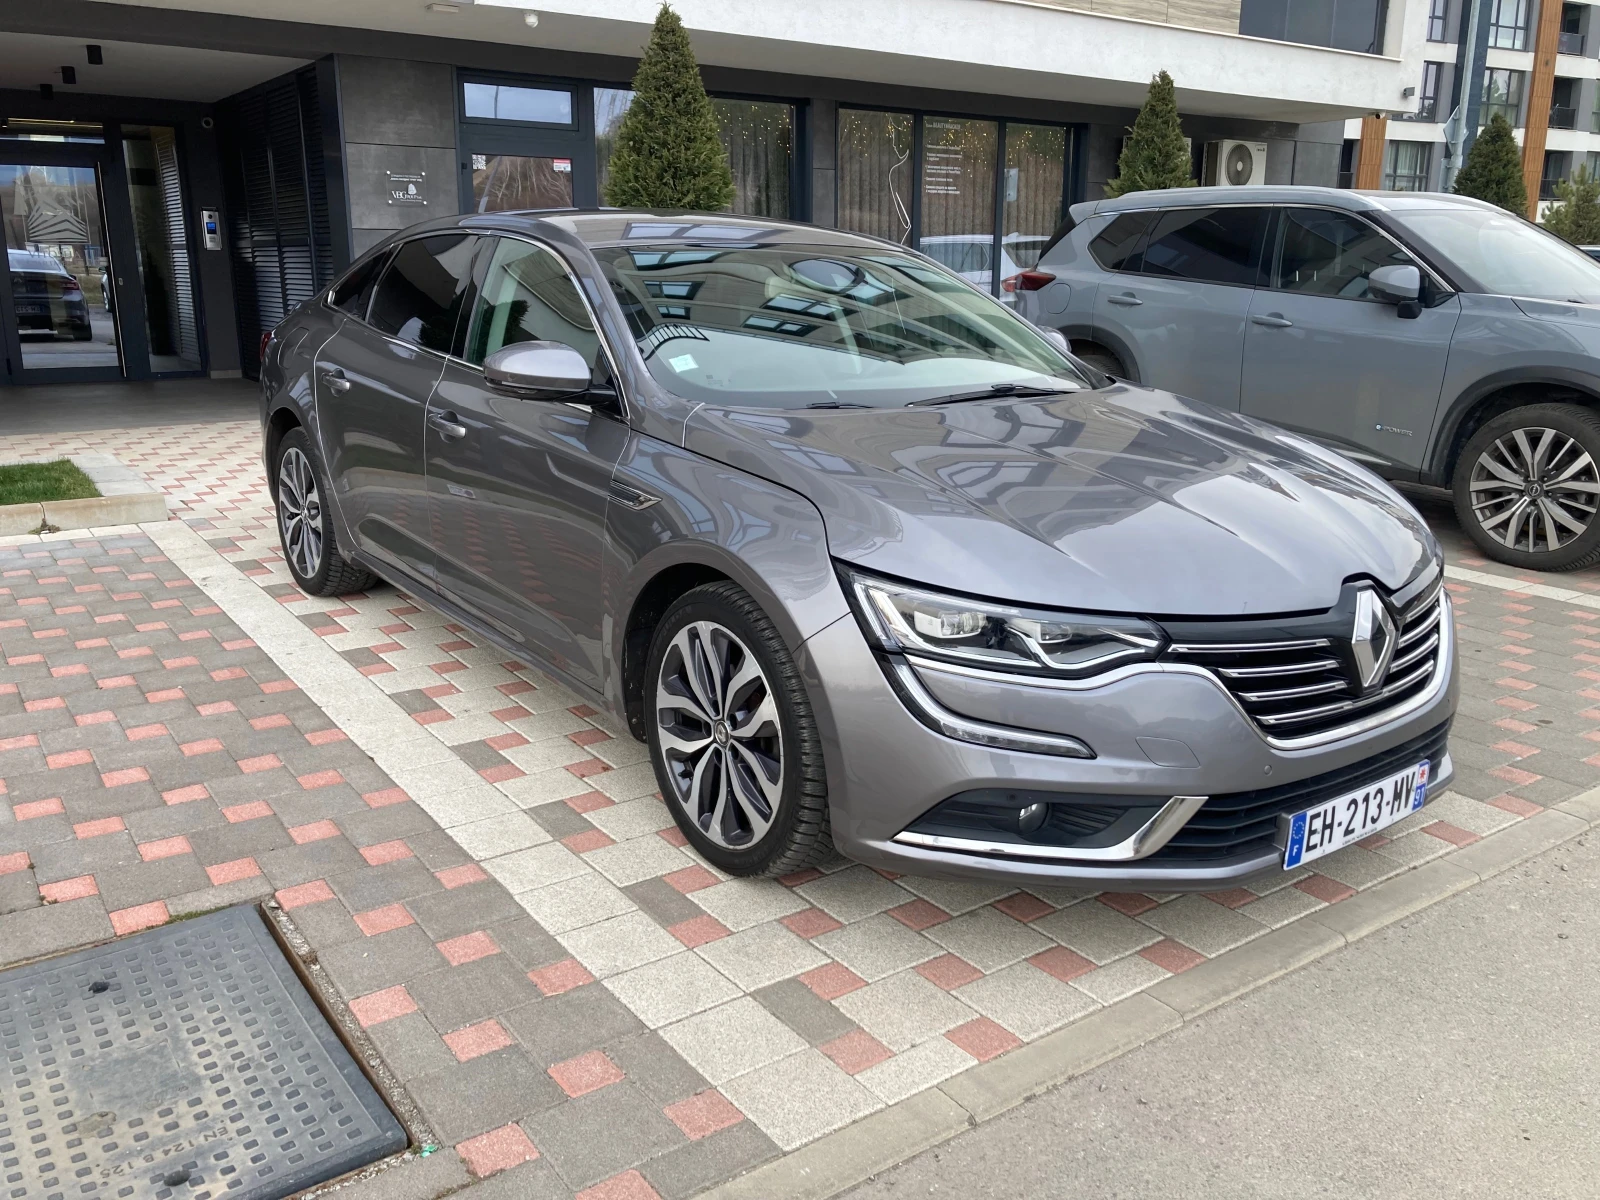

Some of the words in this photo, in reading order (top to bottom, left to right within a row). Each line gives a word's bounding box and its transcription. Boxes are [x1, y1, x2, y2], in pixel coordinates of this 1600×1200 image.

[1414, 786, 1425, 805] 91
[1305, 771, 1416, 853] EH-213-MV
[1293, 844, 1300, 857] F
[203, 1126, 229, 1142] EN
[162, 1140, 195, 1157] 124
[143, 1153, 155, 1164] B
[100, 1161, 134, 1179] 125
